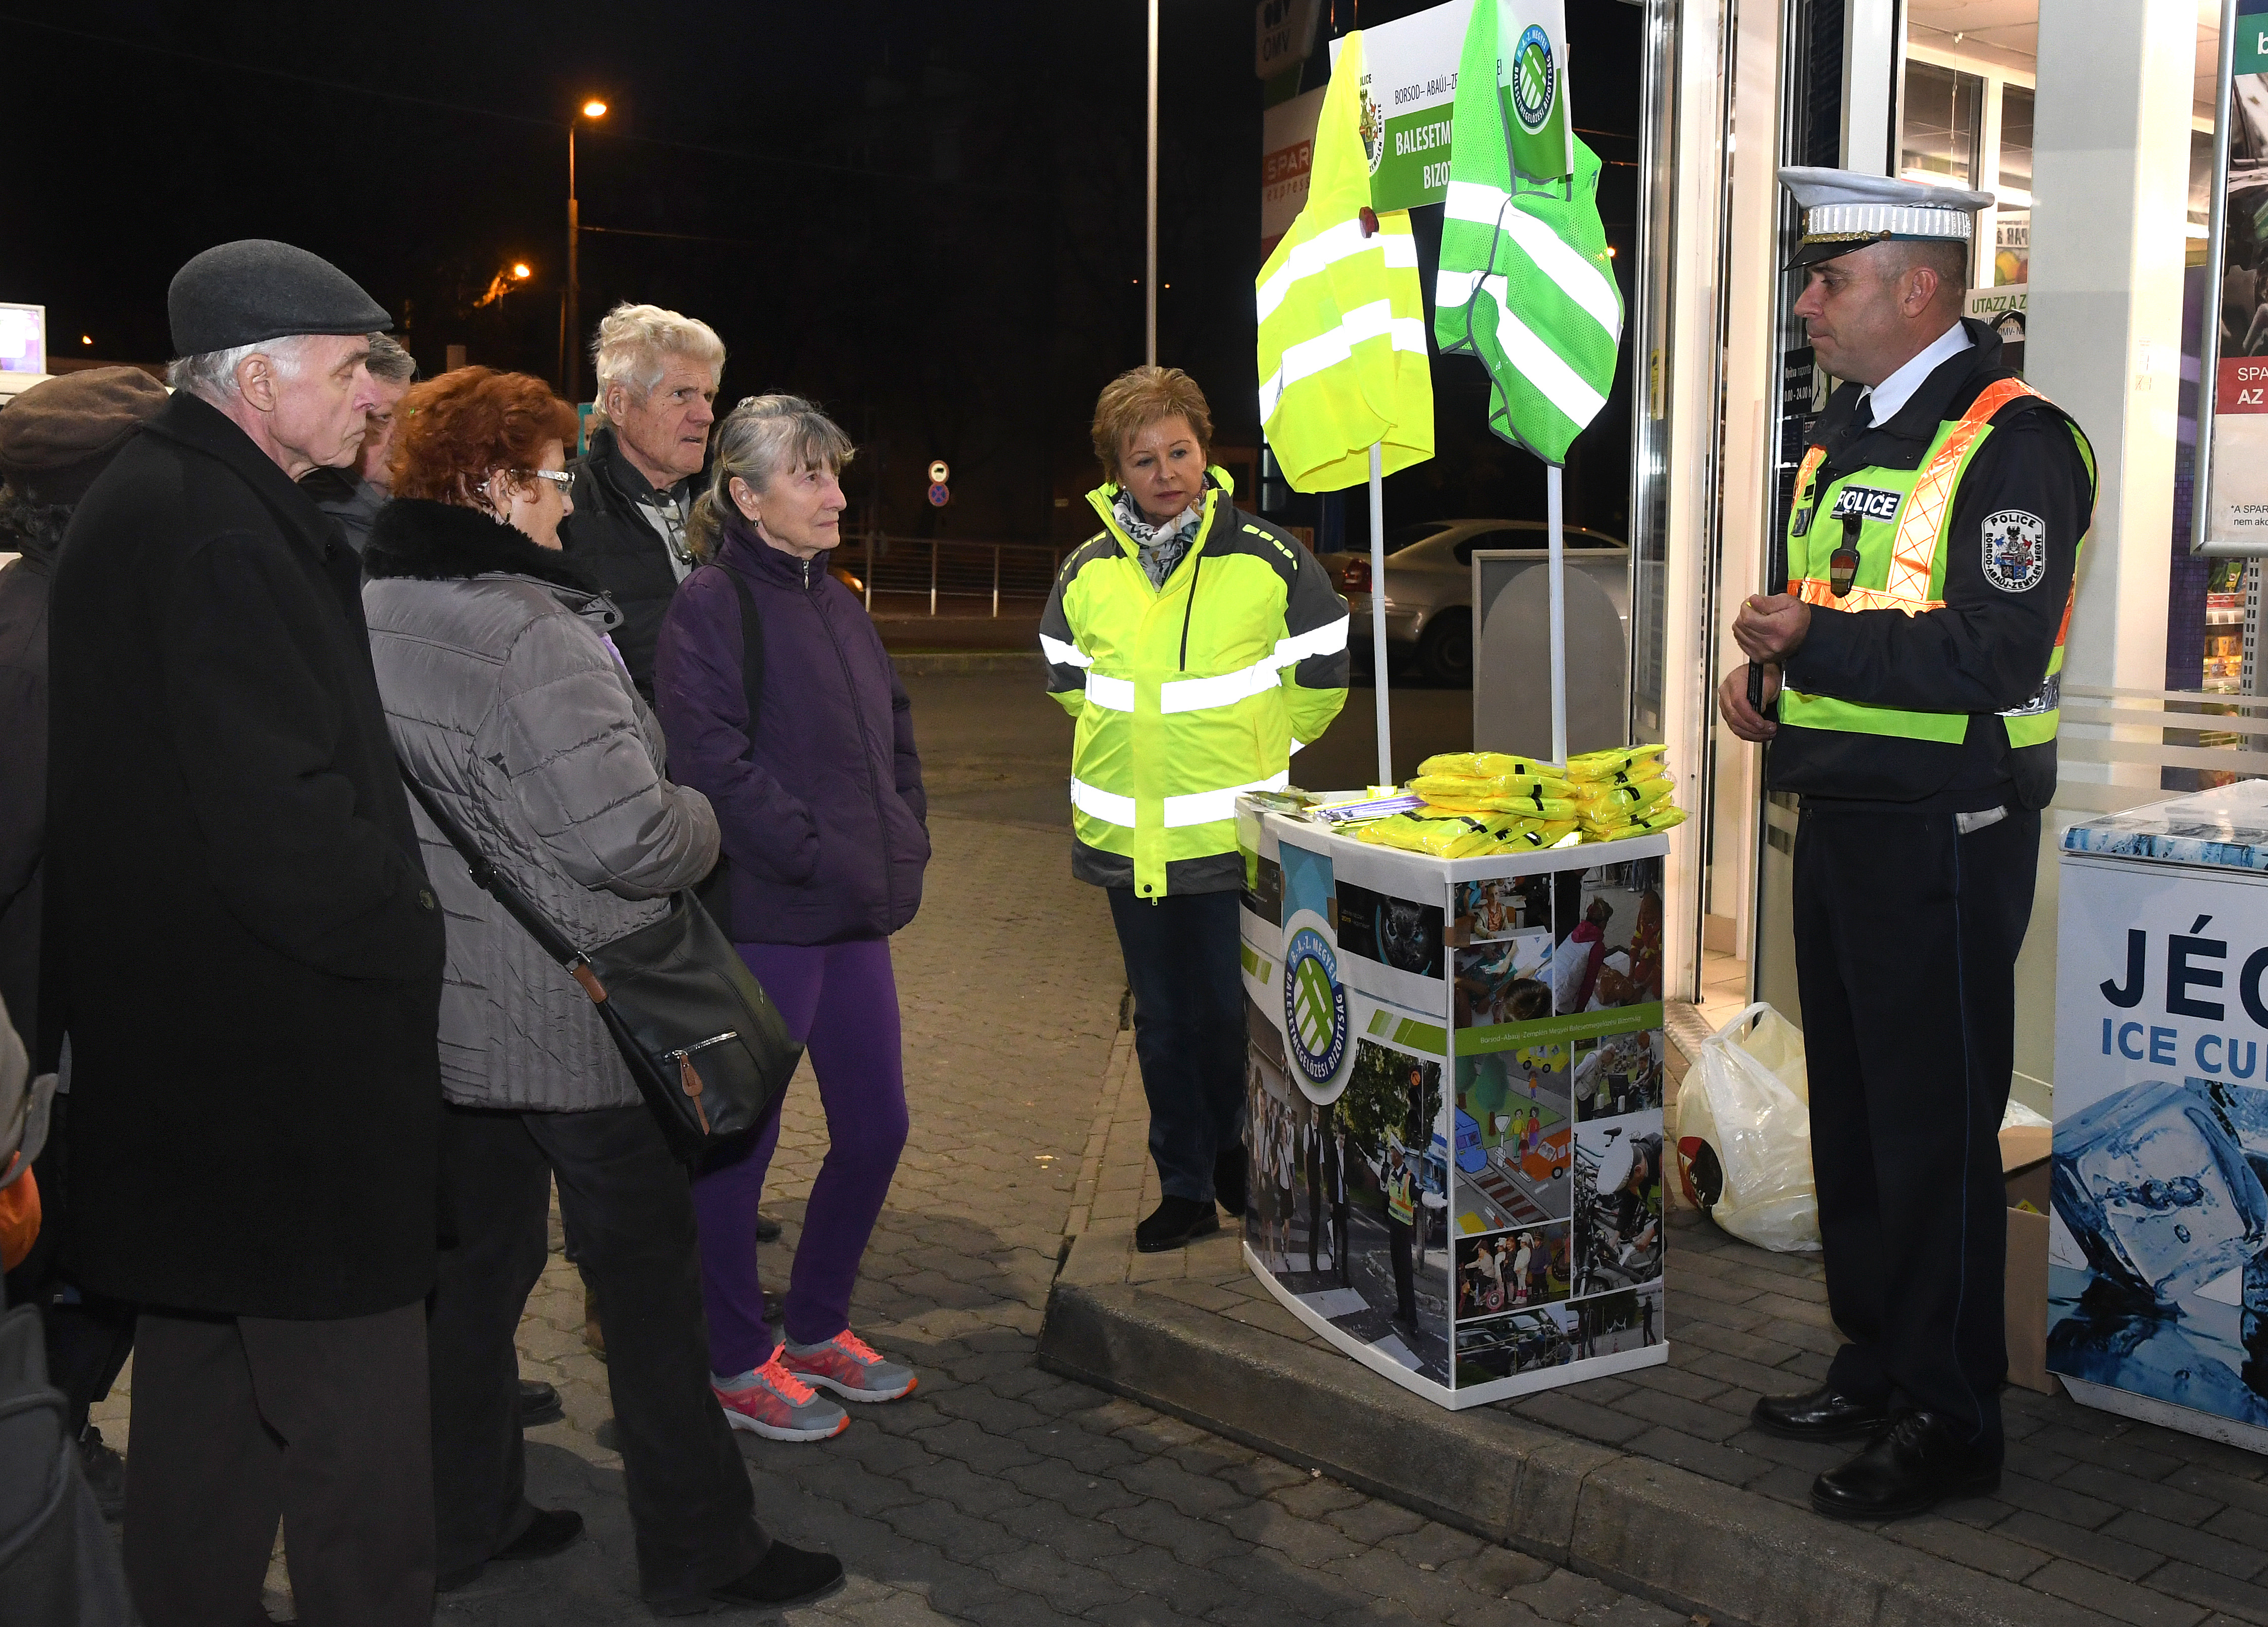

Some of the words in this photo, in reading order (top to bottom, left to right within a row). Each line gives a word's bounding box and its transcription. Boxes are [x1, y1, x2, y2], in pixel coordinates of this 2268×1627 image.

[1264, 31, 1289, 61] OMV
[1532, 29, 1547, 50] MEGYEI
[1543, 55, 1553, 110] BIZOTTSÁG
[1396, 120, 1453, 156] BALESETM
[1268, 147, 1309, 180] SPAR
[1972, 296, 2007, 313] UTAZZ
[2009, 295, 2017, 309] A
[1796, 386, 1808, 400] 24.00
[2237, 388, 2264, 405] AZ
[1834, 490, 1898, 516] POLICE
[1990, 514, 2036, 529] POLICE
[1286, 971, 1329, 1078] BALESETMEGELŐZÉSI
[1328, 993, 1345, 1070] BIZOTTSÁG
[2102, 1018, 2177, 1067] ICE
[2194, 1034, 2268, 1083] CU
